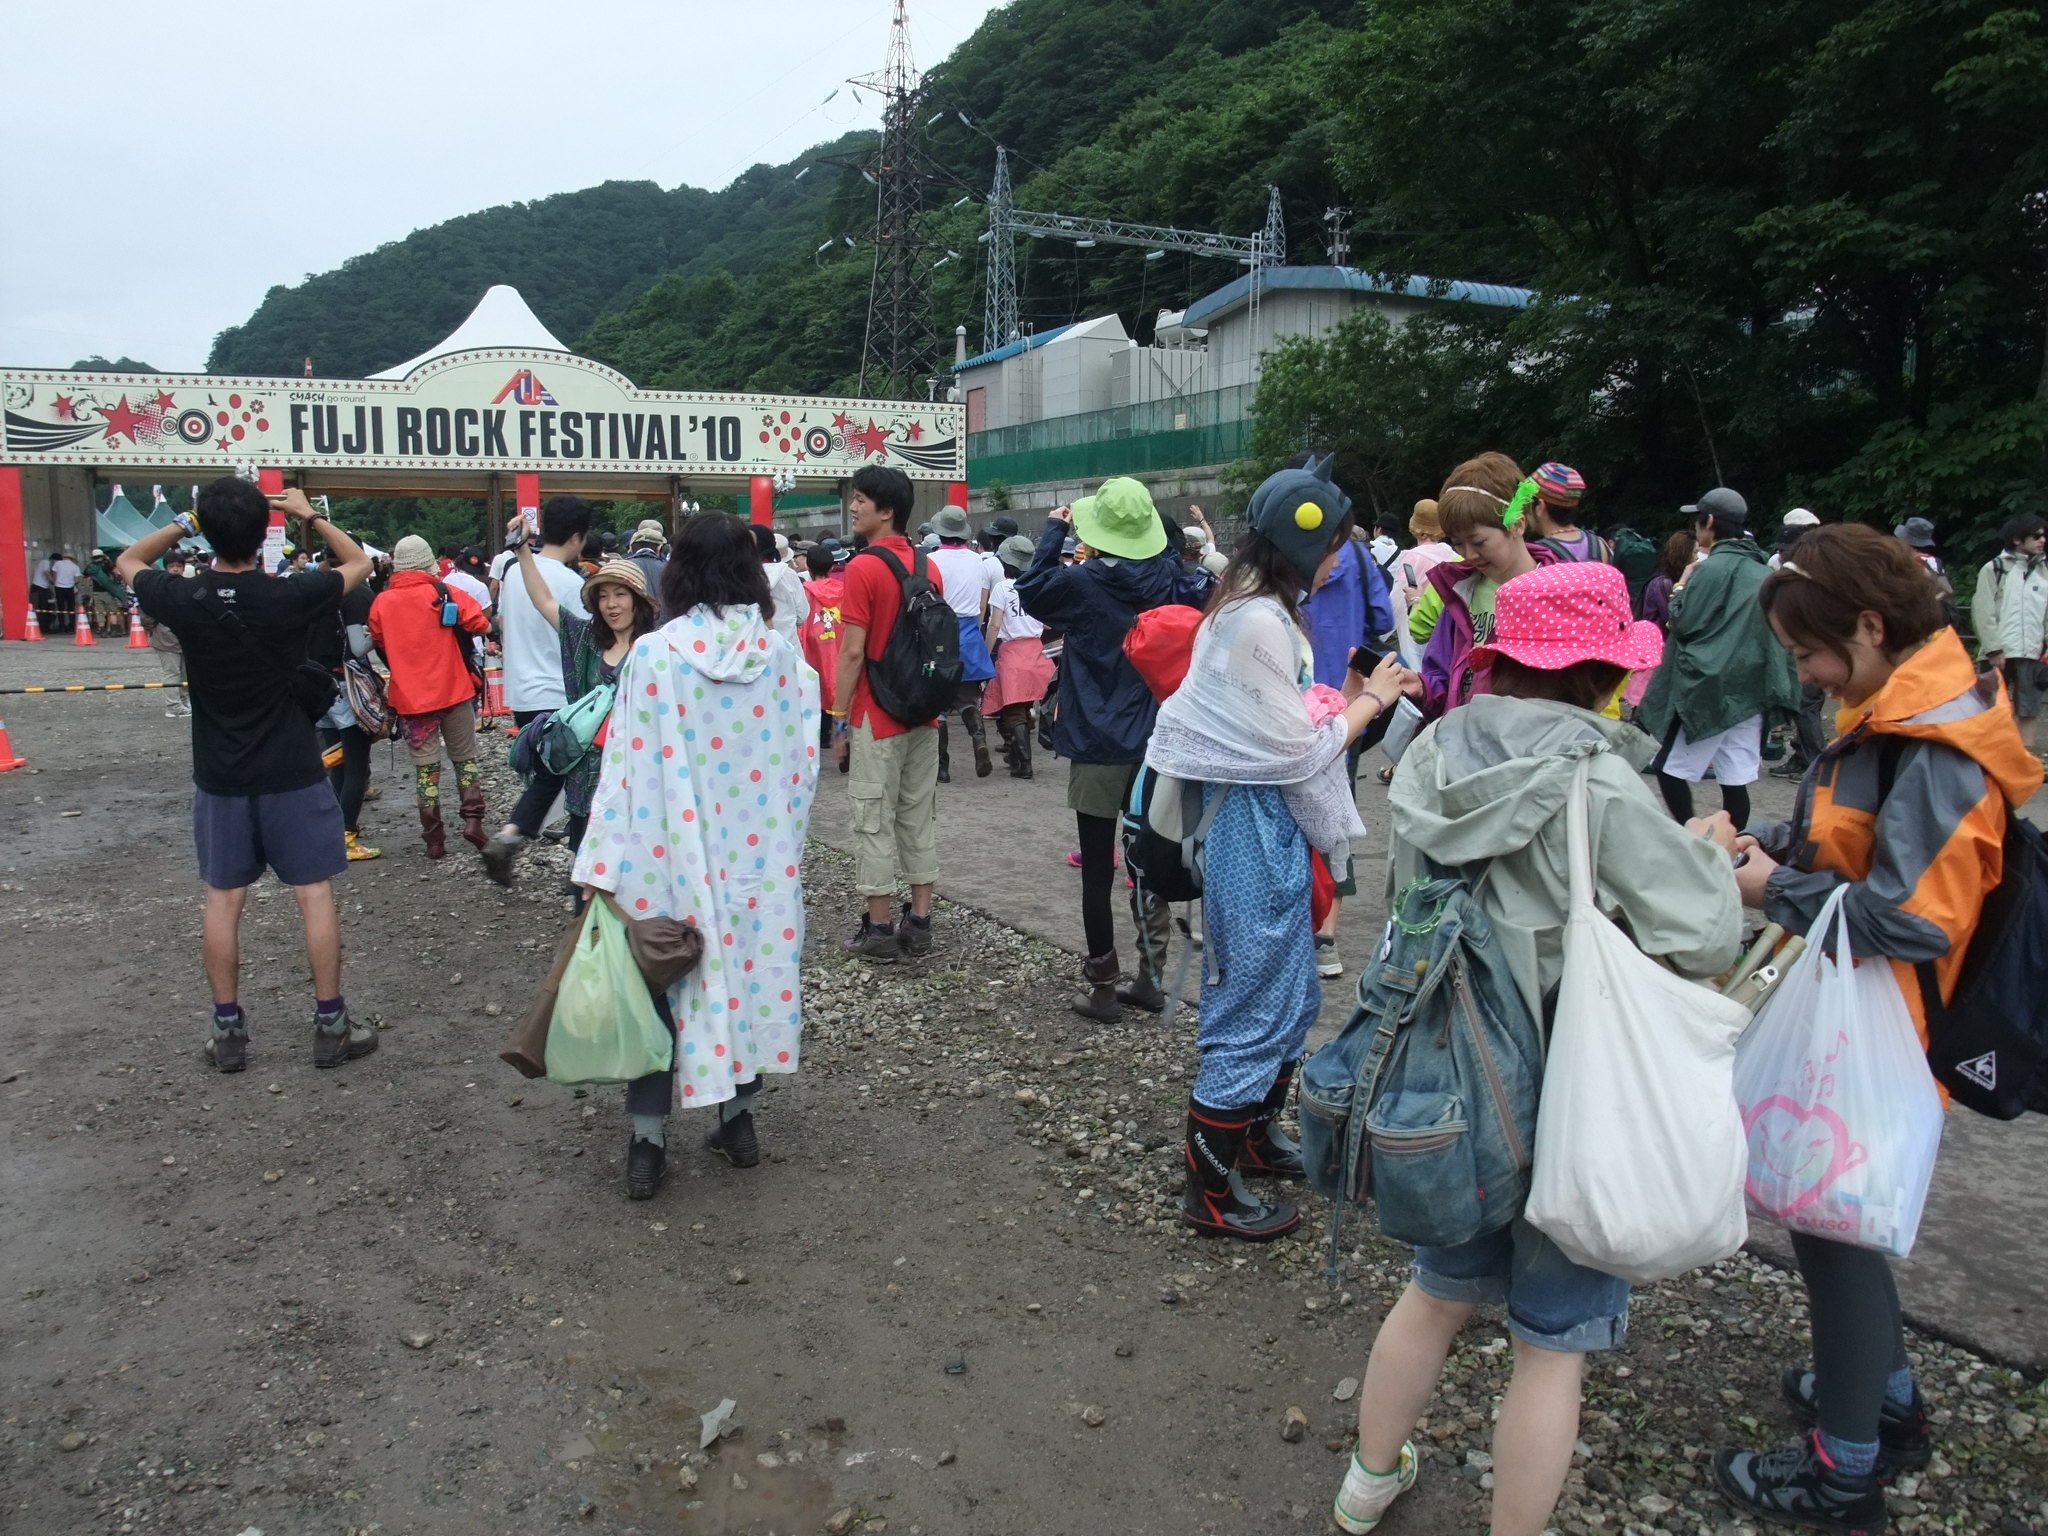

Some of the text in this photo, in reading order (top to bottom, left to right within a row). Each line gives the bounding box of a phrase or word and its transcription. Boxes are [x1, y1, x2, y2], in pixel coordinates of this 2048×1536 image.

[290, 392, 325, 402] SMASH
[290, 404, 384, 455] FUJI
[398, 407, 509, 458] ROCK
